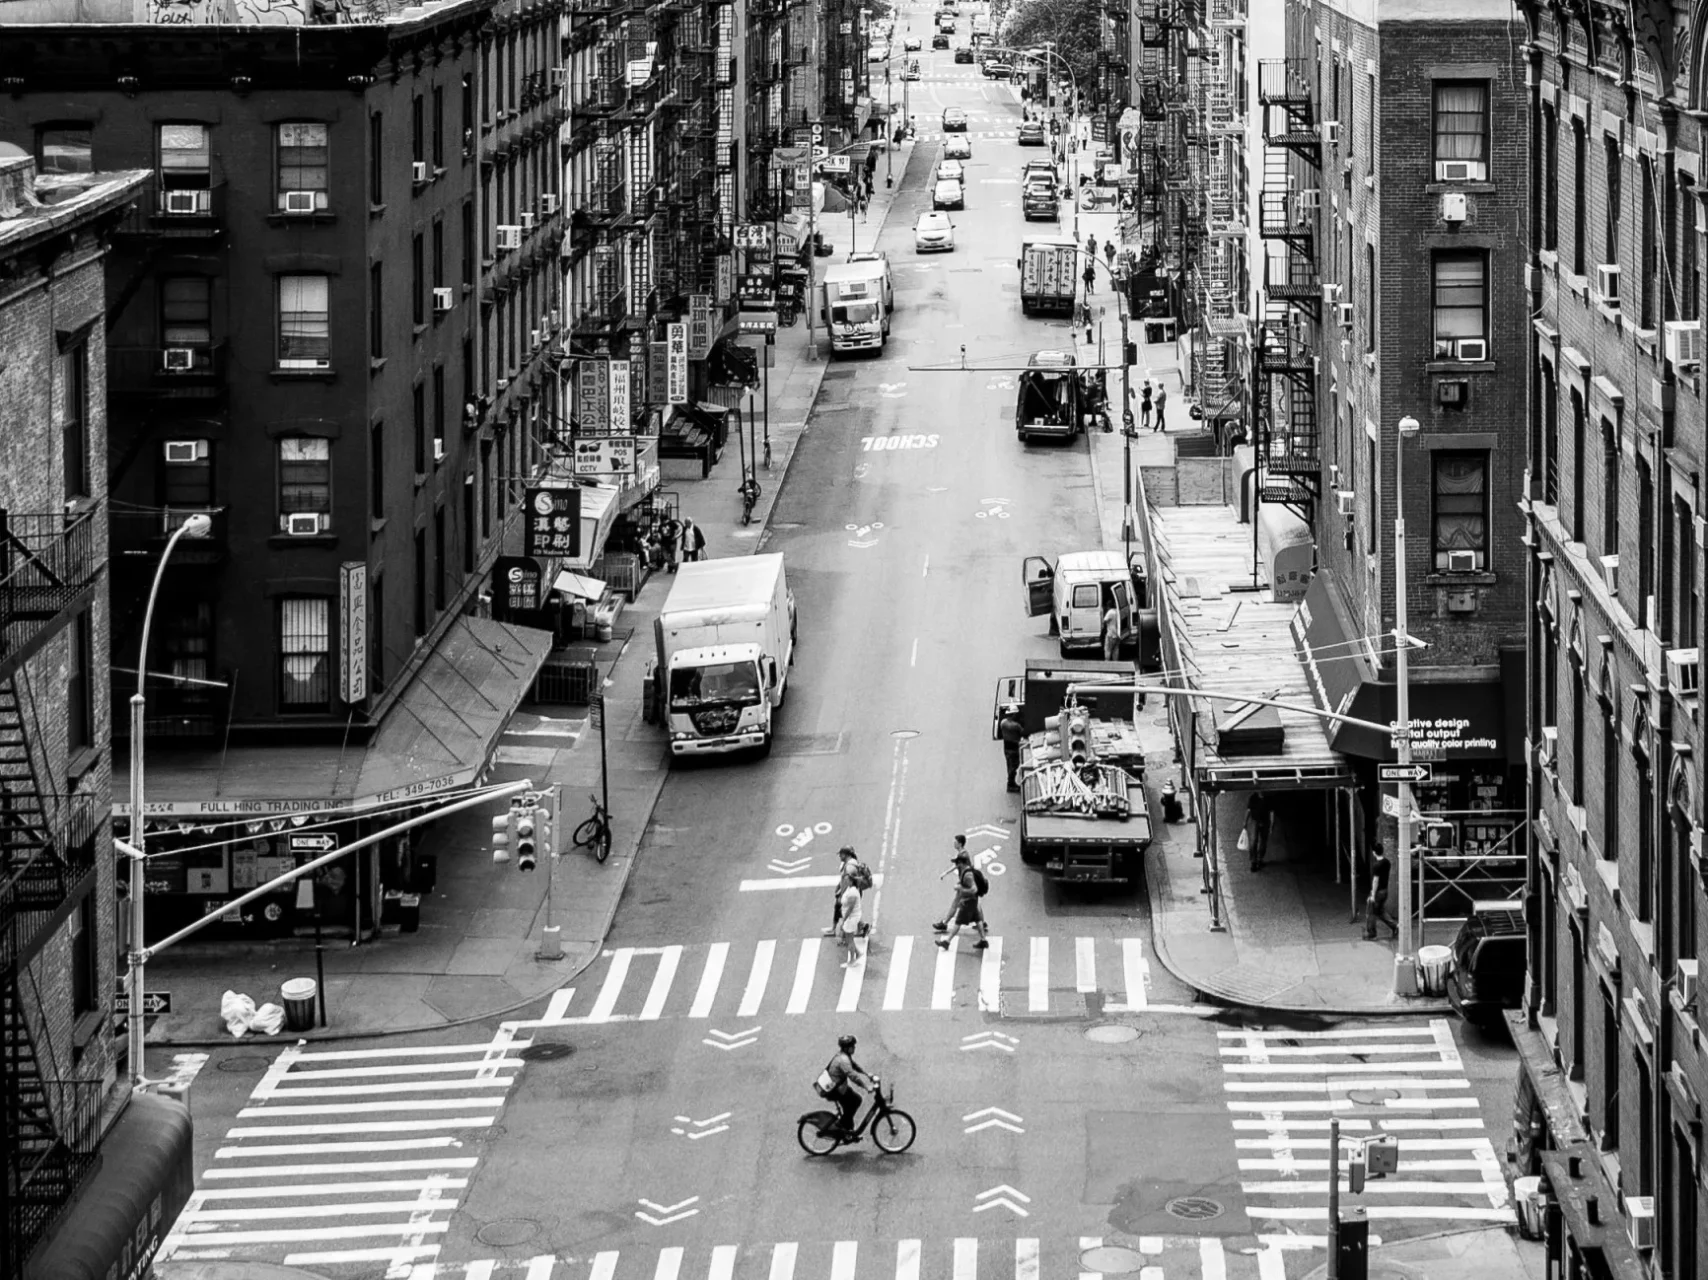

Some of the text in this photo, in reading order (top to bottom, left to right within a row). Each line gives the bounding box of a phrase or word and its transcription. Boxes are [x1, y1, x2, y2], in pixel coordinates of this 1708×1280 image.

[861, 434, 941, 452] SCHOOL
[535, 491, 568, 515] Sino
[508, 567, 538, 583] Sino
[1435, 718, 1470, 730] design
[1427, 729, 1461, 739] output
[1411, 739, 1440, 750] quality
[1441, 739, 1463, 749] color
[1464, 738, 1497, 750] printing
[1385, 769, 1423, 777] ONE WAY
[376, 776, 454, 804] TEL: 349-7036
[200, 802, 229, 813] FULL
[235, 801, 262, 812] HING
[267, 801, 320, 812] TRADING
[316, 839, 330, 847] WAY
